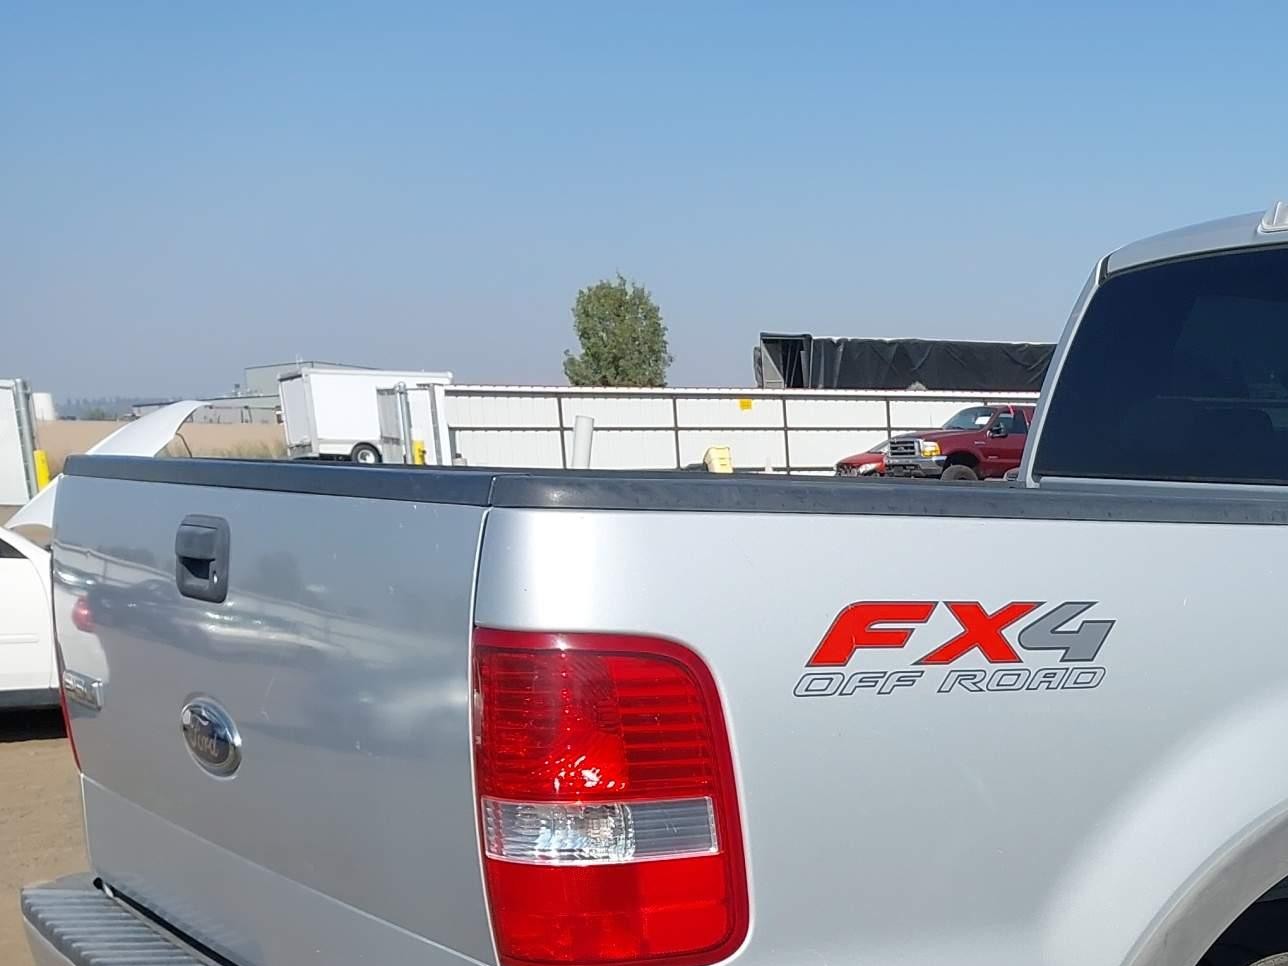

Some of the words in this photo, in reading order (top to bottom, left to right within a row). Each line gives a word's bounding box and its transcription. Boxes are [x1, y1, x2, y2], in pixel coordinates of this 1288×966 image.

[805, 600, 1116, 667] FX4
[793, 671, 924, 698] OFF
[937, 666, 1108, 694] ROAD
